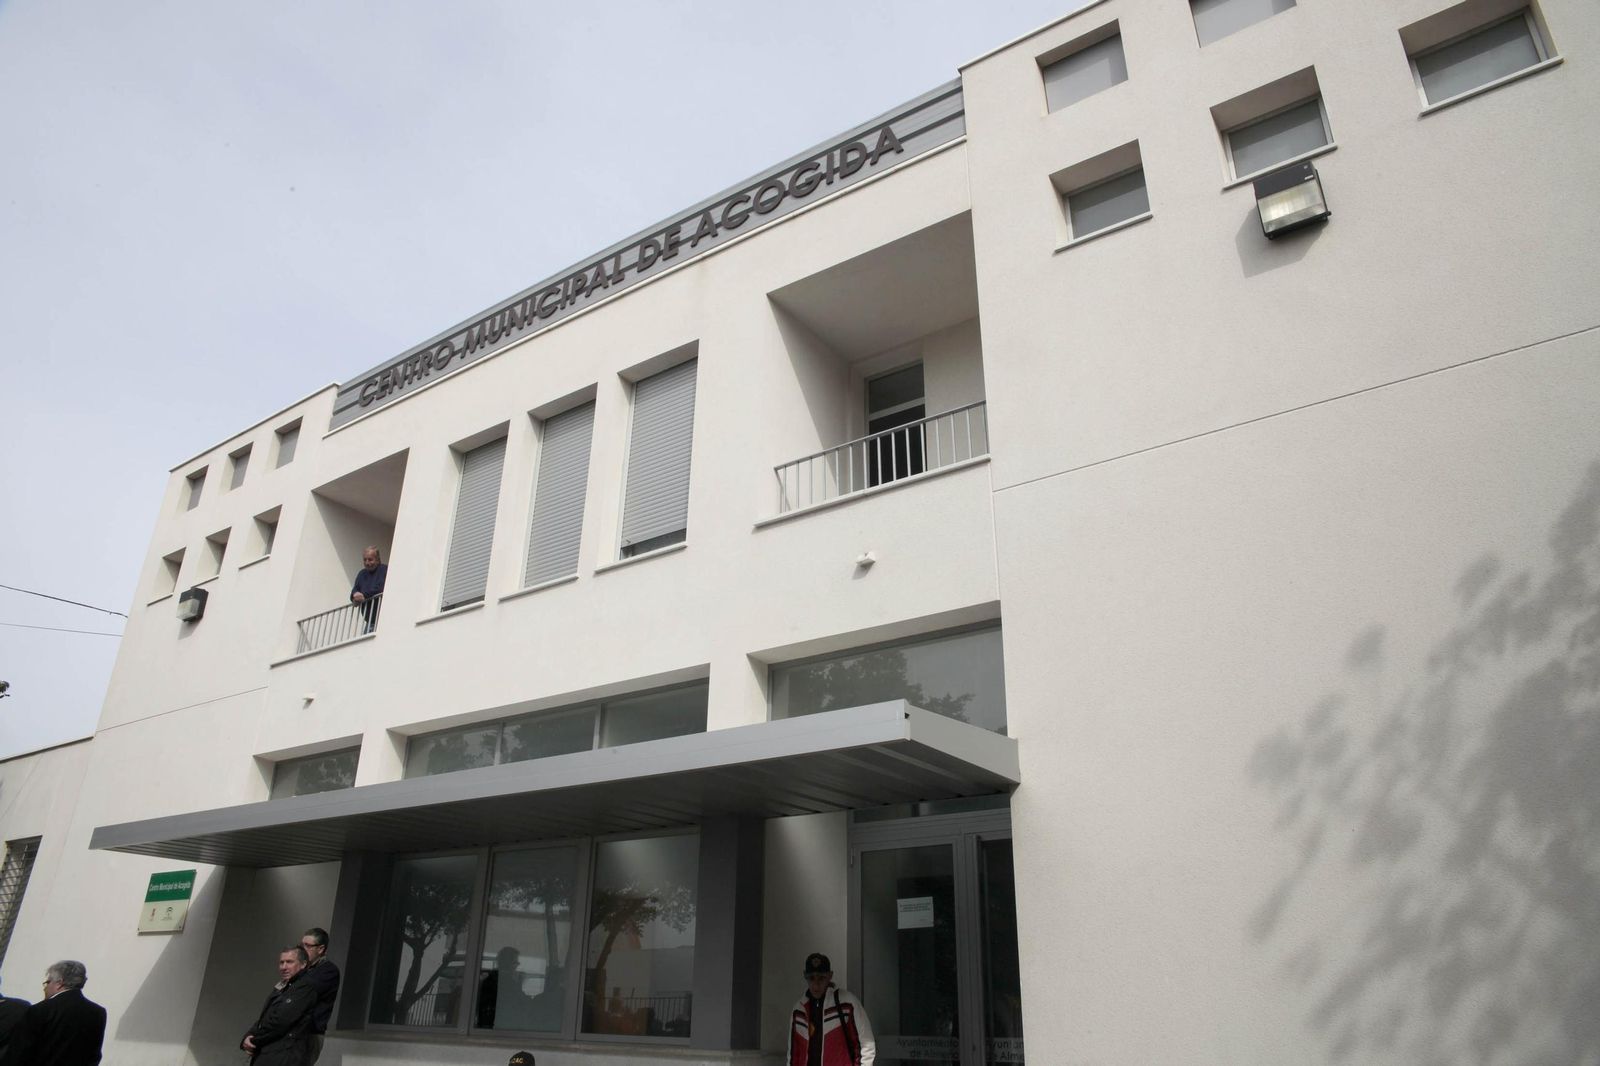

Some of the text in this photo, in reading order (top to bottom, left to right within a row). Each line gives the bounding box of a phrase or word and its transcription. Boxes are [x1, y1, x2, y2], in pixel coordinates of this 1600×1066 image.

[358, 126, 904, 407] CENTRO MUNICIPAL DE ACOGIDA
[159, 882, 173, 891] Municipal
[178, 881, 191, 891] Acogida
